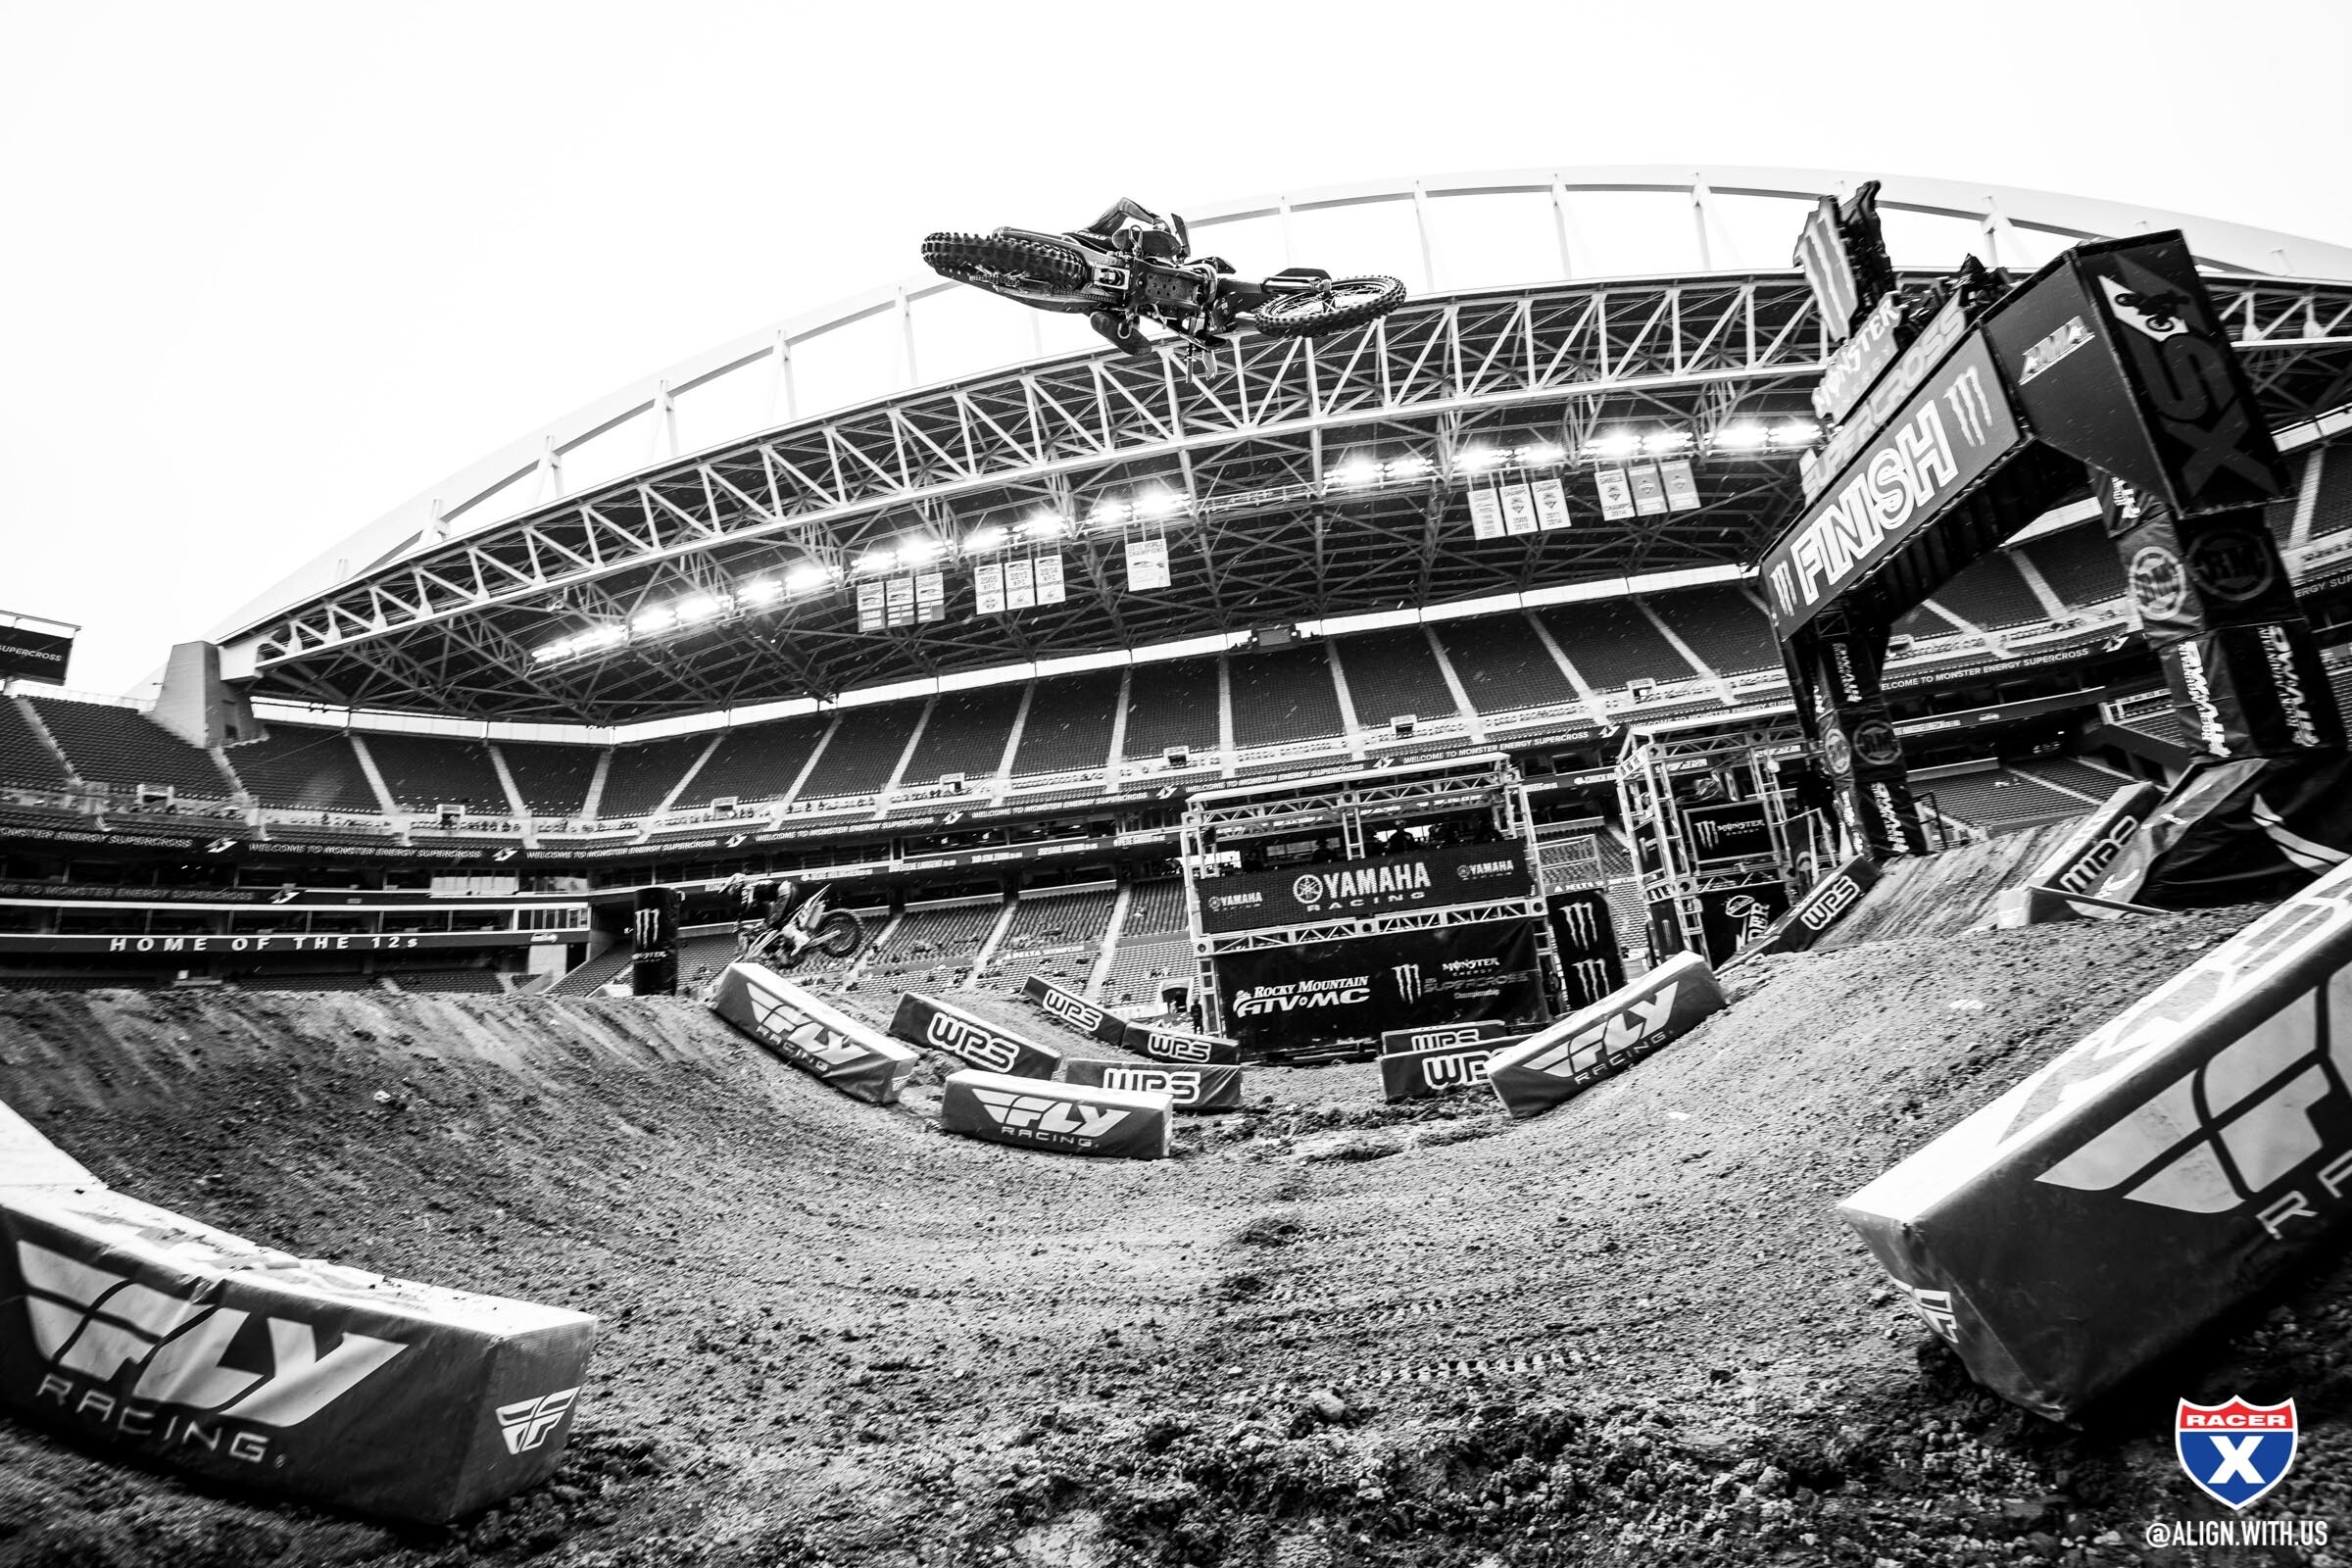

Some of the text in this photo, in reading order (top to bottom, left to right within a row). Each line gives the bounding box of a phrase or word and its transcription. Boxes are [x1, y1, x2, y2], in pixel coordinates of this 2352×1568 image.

[1790, 400, 1958, 606] FINISH
[2294, 582, 2327, 599] ERGY
[1882, 648, 2089, 691] ELCOME TO MONSTER ENERGY SUPERCROSS
[1403, 731, 1589, 764] WELCOME TO MONSTER ENERGY SUPERCROSS
[0, 826, 53, 839] ONSTER
[1324, 862, 1431, 899] YAMAHA
[1469, 859, 1514, 875] YAMAHA
[1220, 891, 1263, 906] YAMAHA
[1307, 891, 1426, 911] RACING
[1800, 875, 1861, 930] WPS
[110, 935, 418, 952] HOME OF THE 12s
[1443, 957, 1500, 971] MONSTER
[1252, 975, 1369, 999] ROCKY MOUNTAIN
[747, 982, 871, 1065] FLY
[1043, 989, 1102, 1031] WPS
[1522, 980, 1679, 1078] FLY
[756, 1025, 830, 1072] RACING
[927, 1011, 1020, 1073] WPS
[1147, 1033, 1212, 1063] WPS
[1574, 1032, 1666, 1086] RACING
[1422, 1047, 1522, 1090] WP
[972, 1089, 1131, 1138] FLY
[1001, 1126, 1093, 1149] RACING
[17, 1240, 410, 1428] FLY
[36, 1372, 270, 1464] RACING
